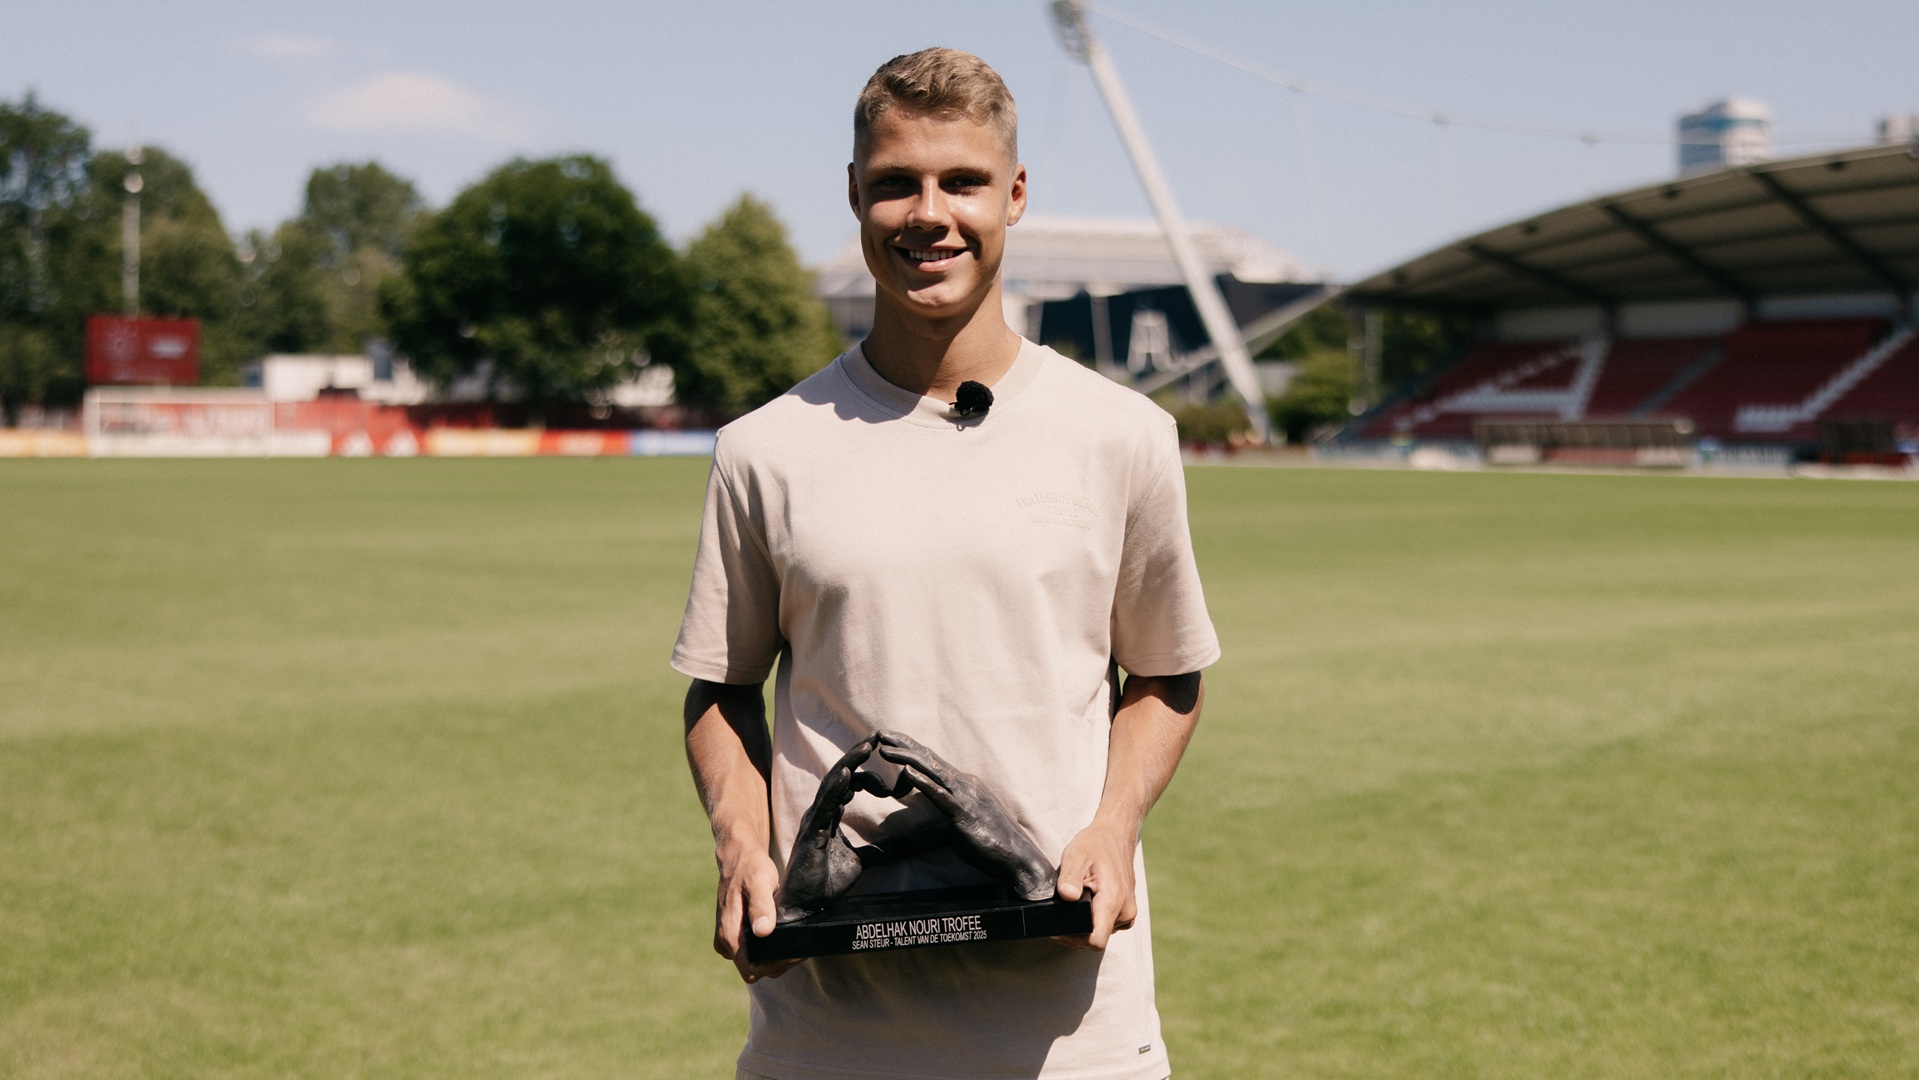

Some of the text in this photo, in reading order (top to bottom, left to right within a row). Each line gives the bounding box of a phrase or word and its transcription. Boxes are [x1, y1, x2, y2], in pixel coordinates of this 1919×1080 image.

[856, 915, 982, 940] ABDELHAK NOURI TROFEE
[852, 940, 869, 950] SEAN
[869, 938, 890, 949] STEUR
[893, 936, 917, 947] TALENT
[917, 934, 929, 944] VAN
[930, 933, 939, 943] DE
[940, 931, 973, 942] TOEKOMST
[973, 930, 988, 940] 2025
